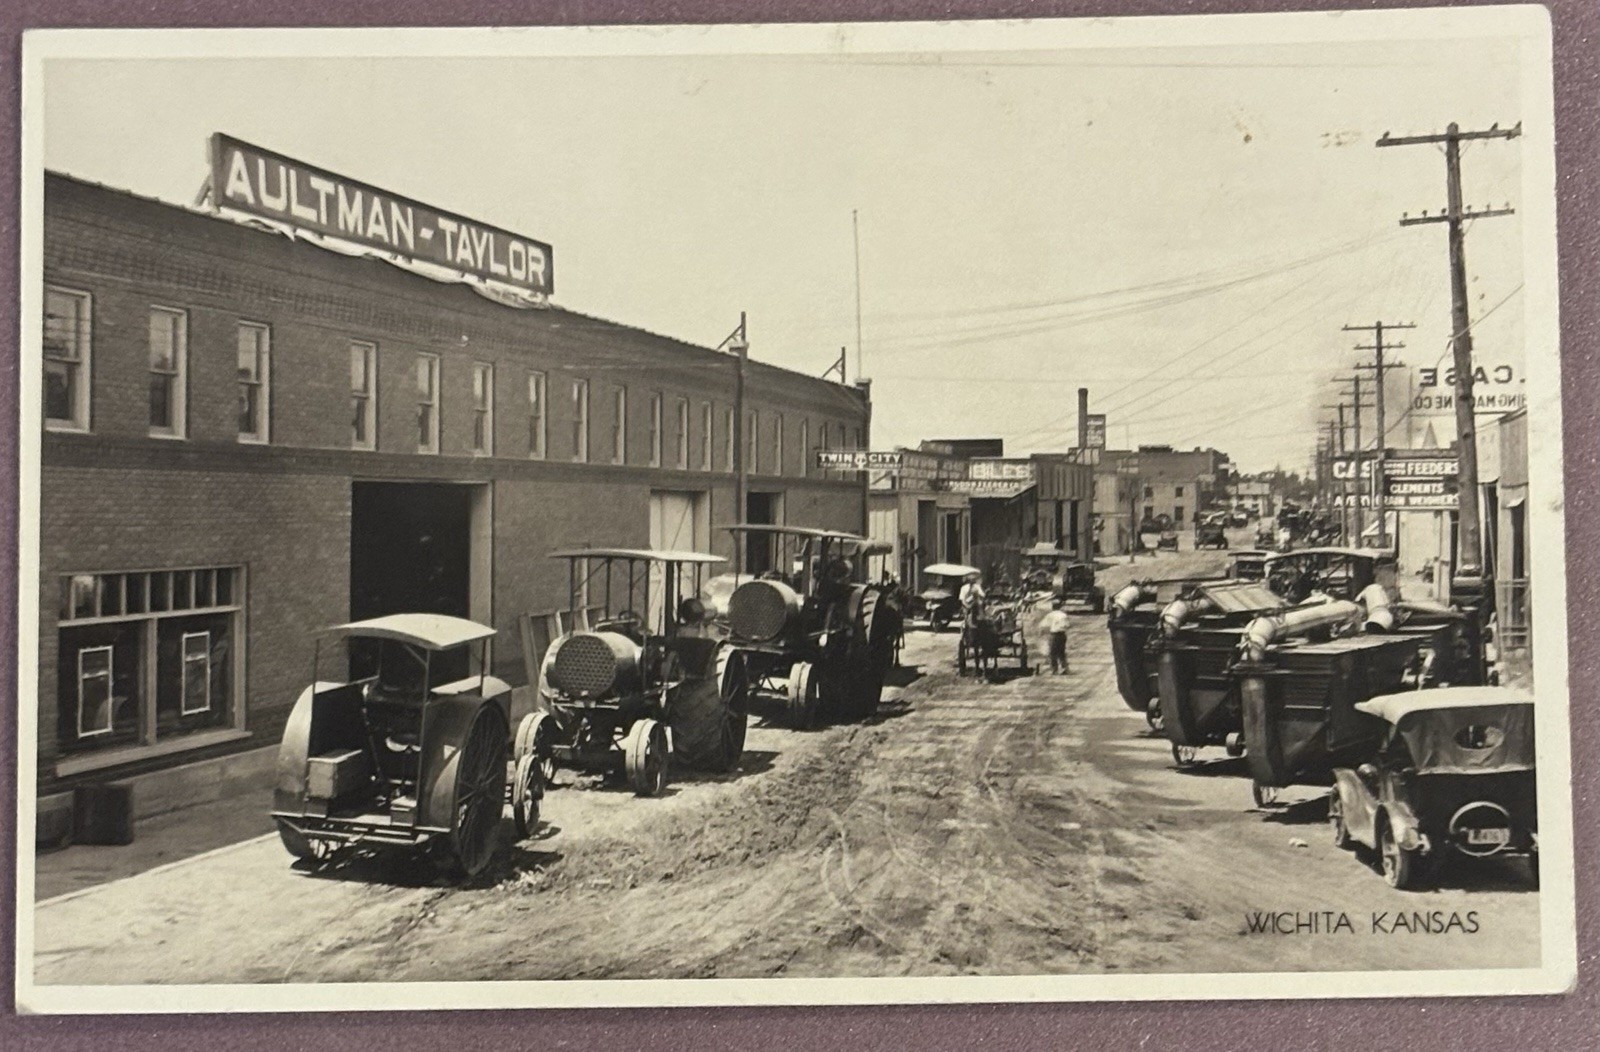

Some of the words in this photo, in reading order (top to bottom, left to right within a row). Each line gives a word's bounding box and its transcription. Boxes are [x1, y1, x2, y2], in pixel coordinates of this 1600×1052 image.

[225, 150, 546, 286] AULTMAN-TAYLOR
[819, 453, 853, 463] TWIN
[869, 453, 902, 463] CITY
